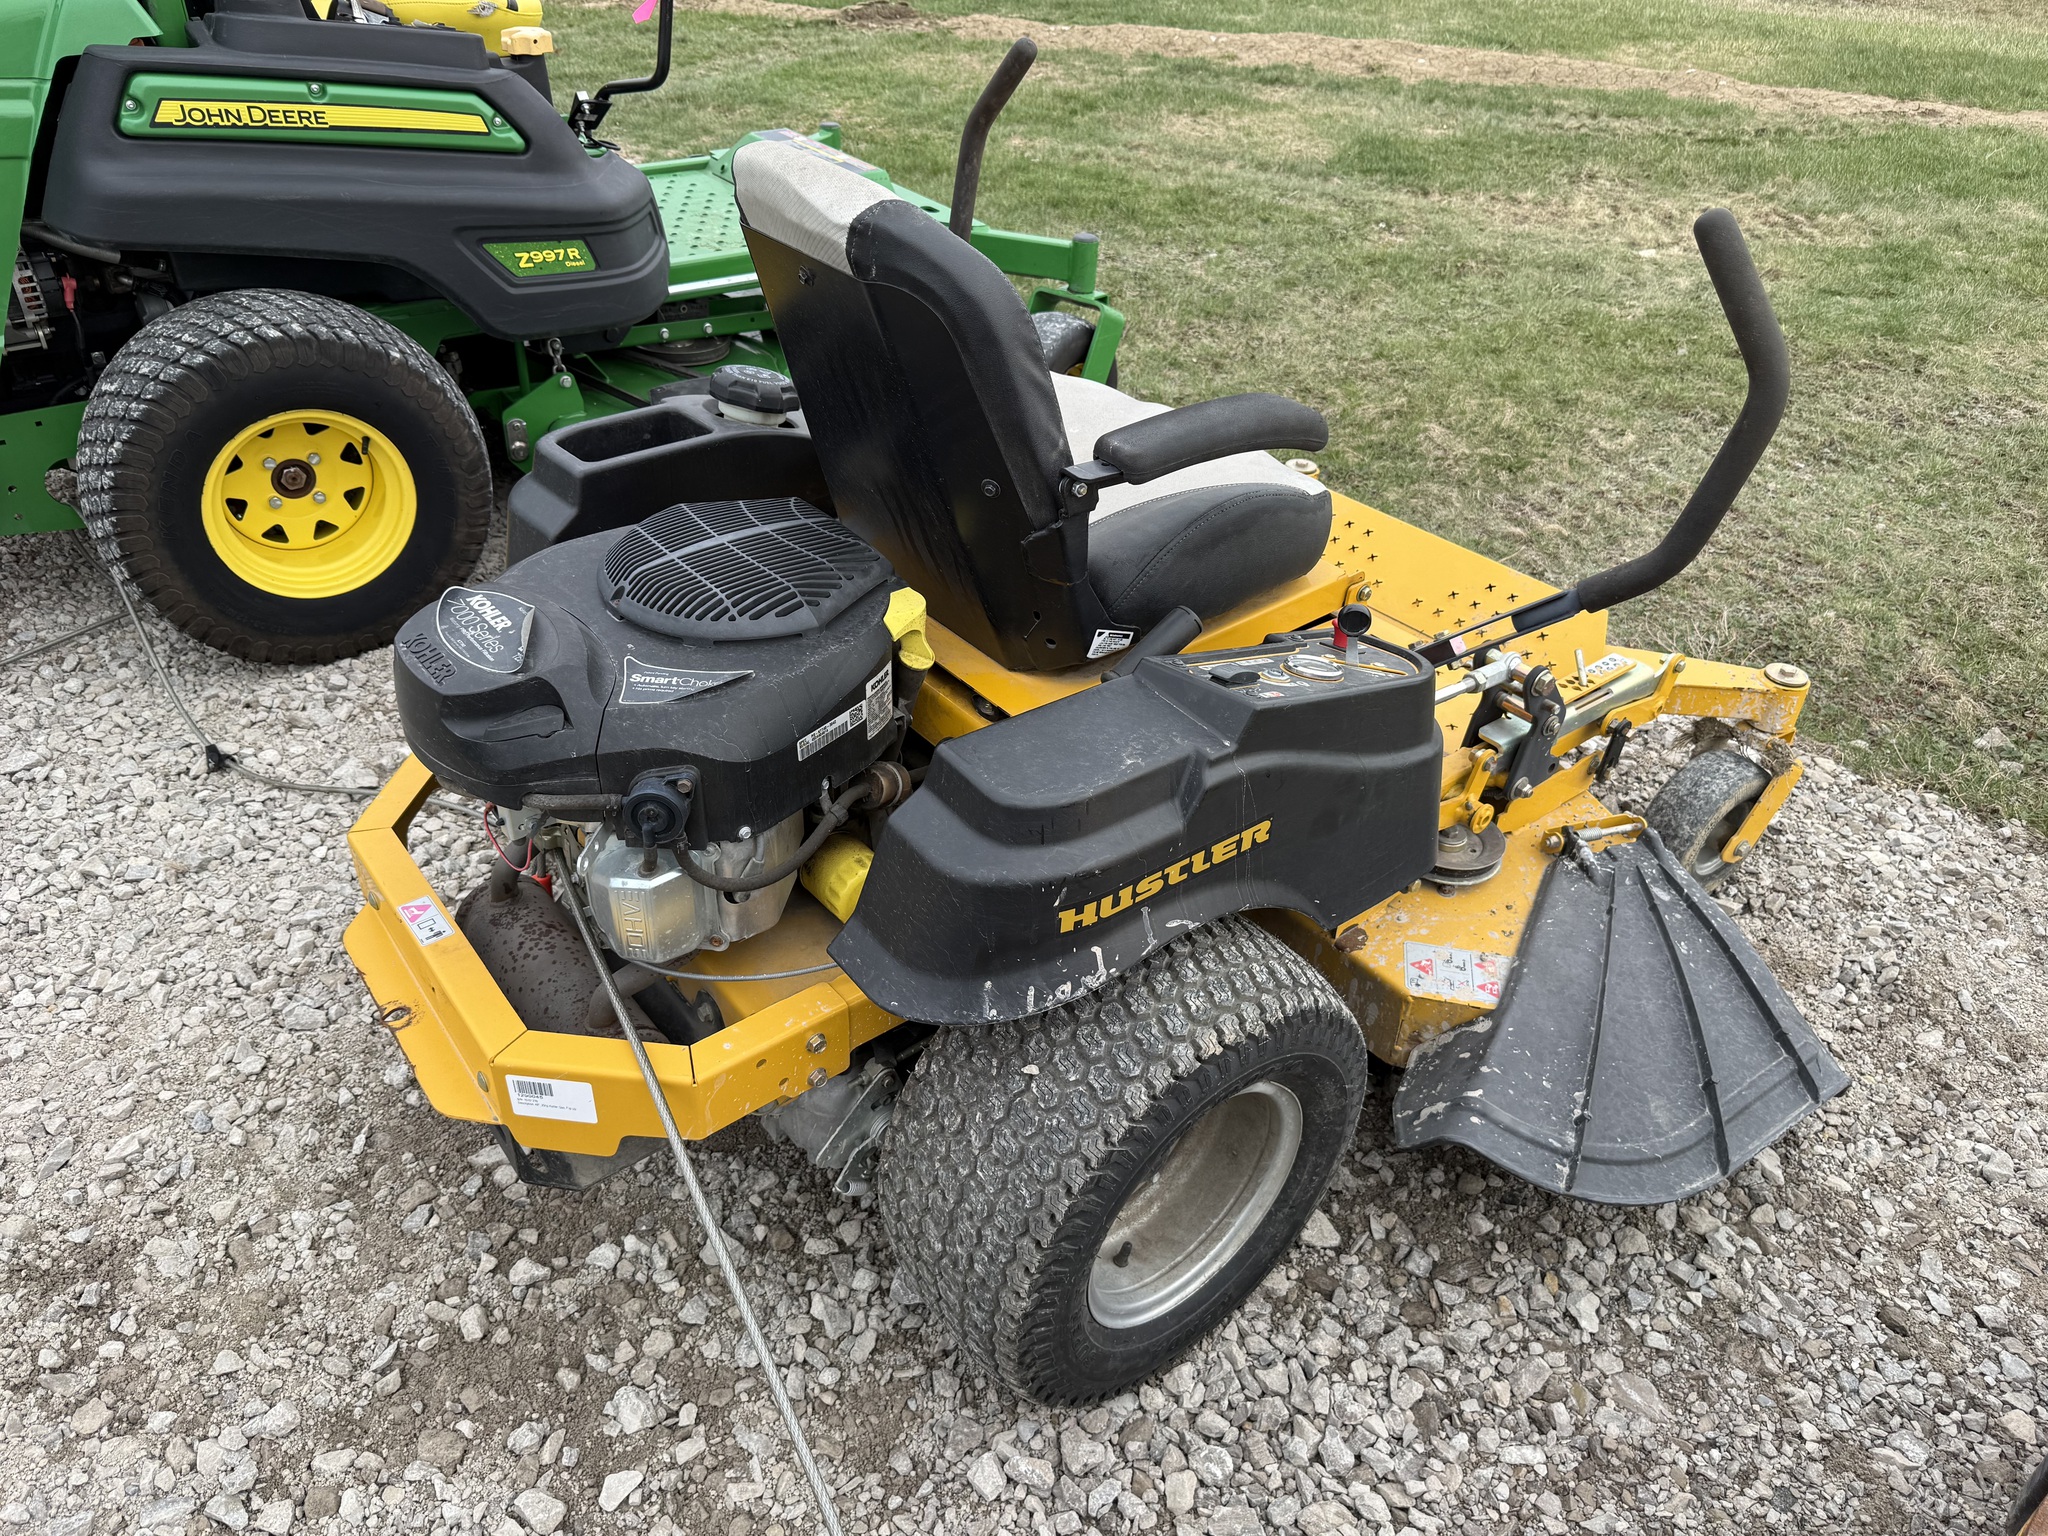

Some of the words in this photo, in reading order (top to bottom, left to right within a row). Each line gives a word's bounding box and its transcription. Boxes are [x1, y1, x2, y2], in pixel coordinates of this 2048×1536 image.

[174, 104, 243, 123] JOHN
[246, 105, 329, 125] DEERE
[446, 598, 480, 626] 7000
[469, 622, 504, 654] Series
[466, 594, 511, 633] KOHLER
[401, 633, 457, 687] KOHLER
[870, 669, 890, 693] KOHLER
[1058, 819, 1272, 934] HUSTLER
